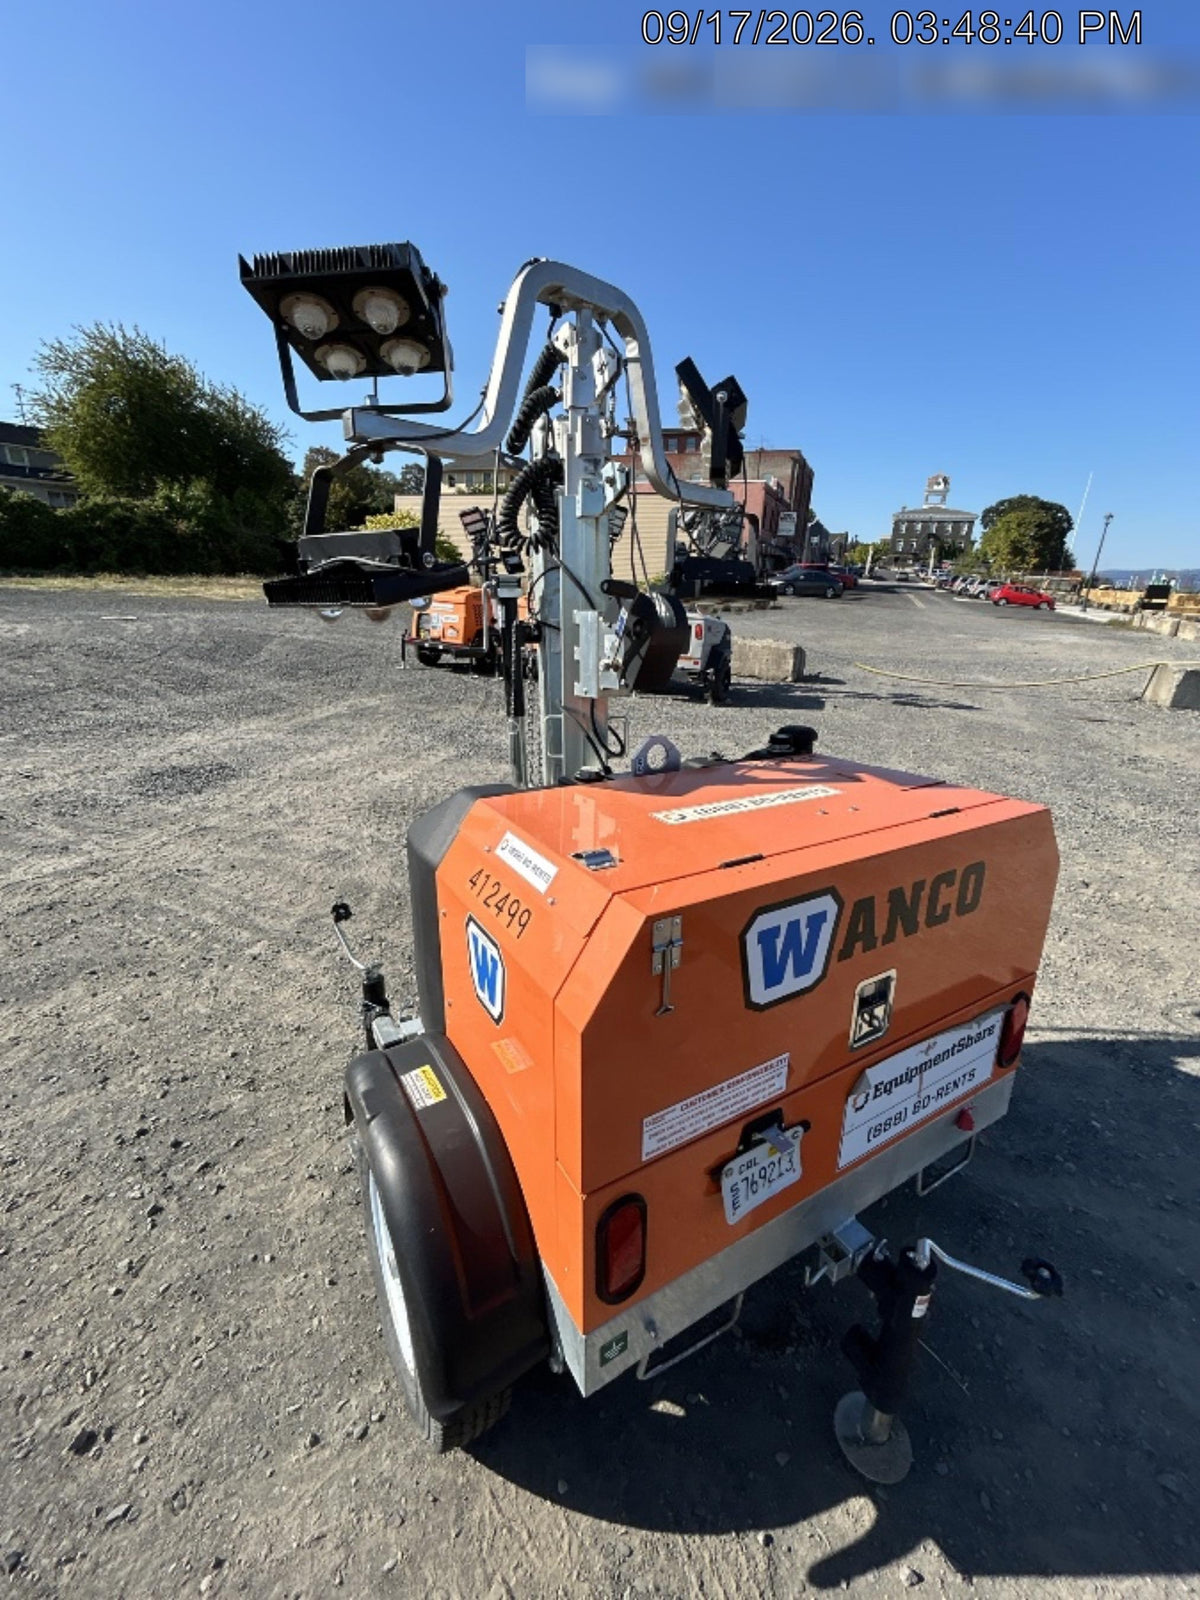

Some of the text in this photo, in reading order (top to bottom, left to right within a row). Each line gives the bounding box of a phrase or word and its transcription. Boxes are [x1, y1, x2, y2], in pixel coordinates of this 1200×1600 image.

[469, 868, 532, 939] 412499
[872, 1022, 996, 1099] EquipmentShare
[866, 1107, 908, 1143] (888)
[738, 1156, 759, 1176] CAL
